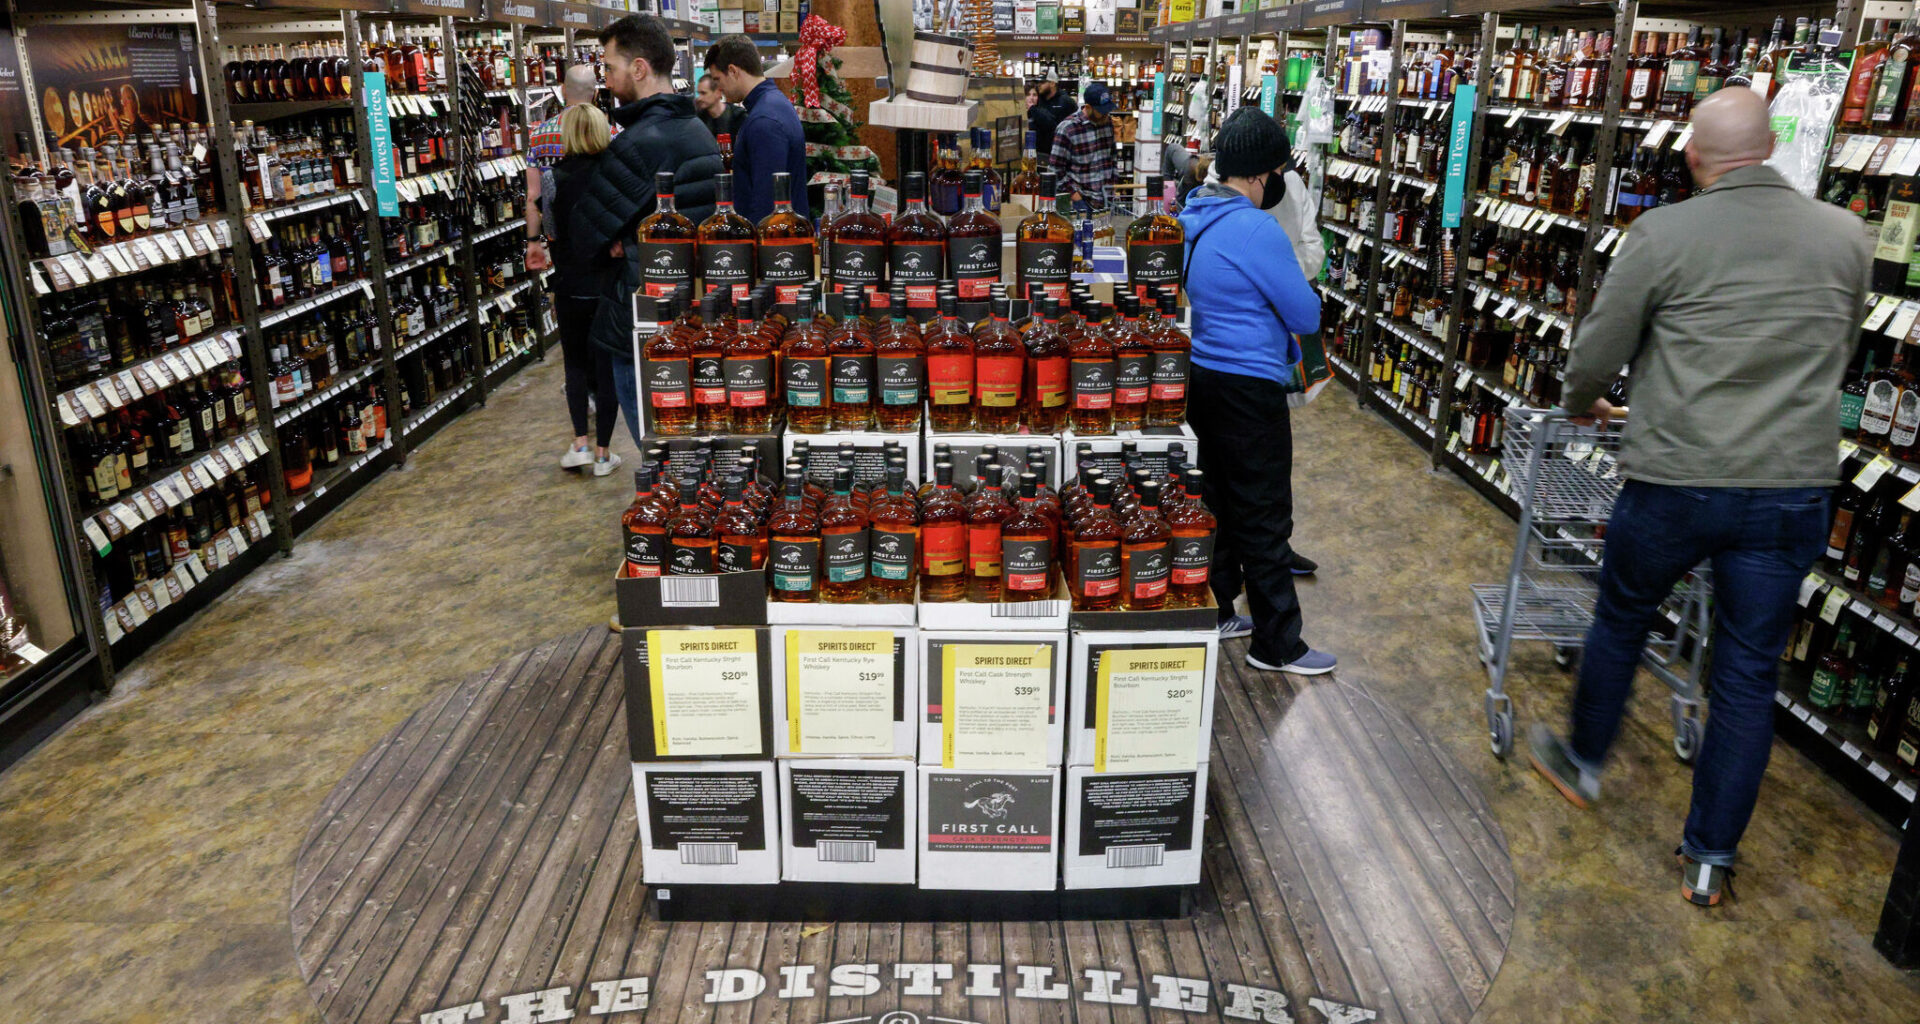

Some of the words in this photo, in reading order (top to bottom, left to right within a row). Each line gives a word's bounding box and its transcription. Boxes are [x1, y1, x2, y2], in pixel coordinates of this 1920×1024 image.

[370, 88, 387, 133] prices
[1452, 121, 1467, 161] Texas
[374, 137, 390, 184] Lowest
[1449, 162, 1462, 177] in
[711, 642, 737, 650] DIRECT
[850, 642, 875, 650] DIRECT
[975, 657, 1004, 665] SPIRITS
[1006, 657, 1032, 665] DIRECT
[1129, 662, 1158, 670] SPIRITS
[1160, 661, 1186, 669] DIRECT
[969, 780, 984, 788] CALL
[1005, 782, 1019, 791] POST
[941, 824, 988, 833] FIRST
[997, 824, 1038, 834] CALL
[420, 977, 649, 1024] THE
[704, 963, 1377, 1024] DISTILLERY
